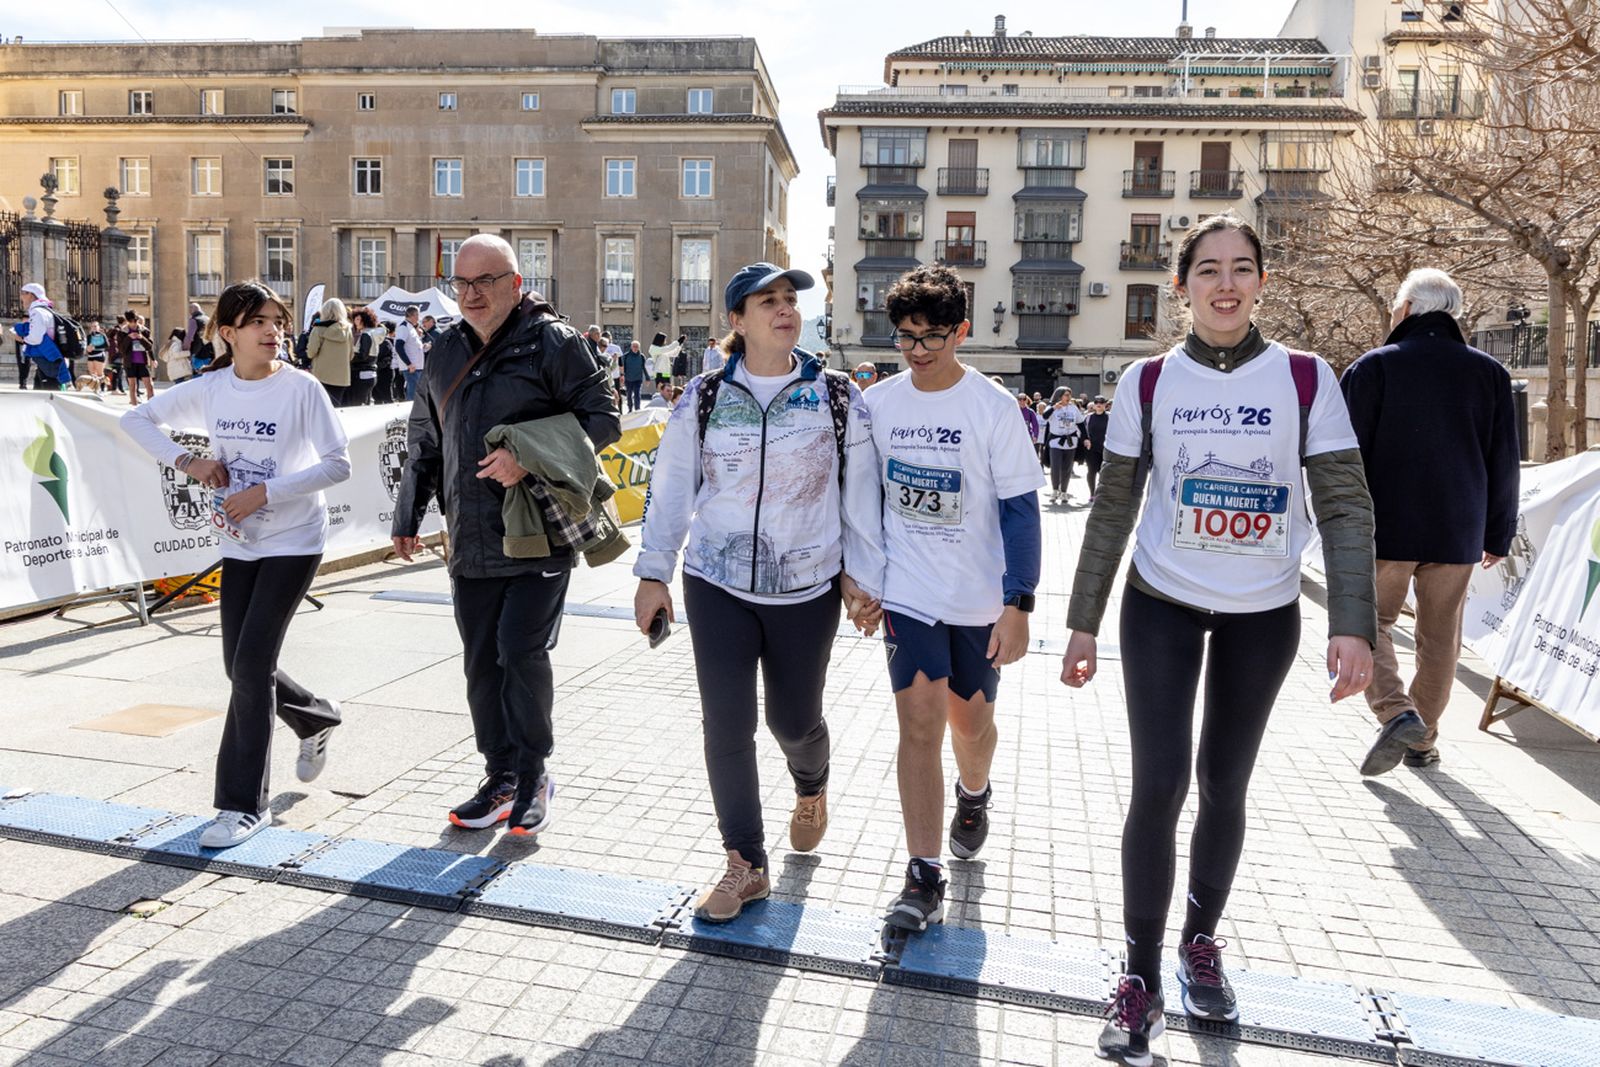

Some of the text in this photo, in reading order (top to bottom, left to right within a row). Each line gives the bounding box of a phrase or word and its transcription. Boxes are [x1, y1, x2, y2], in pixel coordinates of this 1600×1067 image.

[1172, 404, 1232, 426] Kairós
[215, 418, 250, 434] Kairós
[890, 425, 933, 443] Kairós
[1172, 428, 1208, 436] Parroquia
[1209, 428, 1241, 436] Santiago
[911, 476, 939, 488] MUERTE
[1204, 482, 1239, 493] CARRERA
[1240, 486, 1277, 496] CAMINATA
[899, 486, 941, 512] 373
[1193, 492, 1260, 509] BUENA MUERTE
[1193, 508, 1272, 540] 1009
[4, 535, 63, 553] Patronato
[106, 528, 119, 540] de
[154, 538, 195, 553] CIUDAD
[198, 536, 212, 548] DE
[85, 543, 109, 557] Jaén
